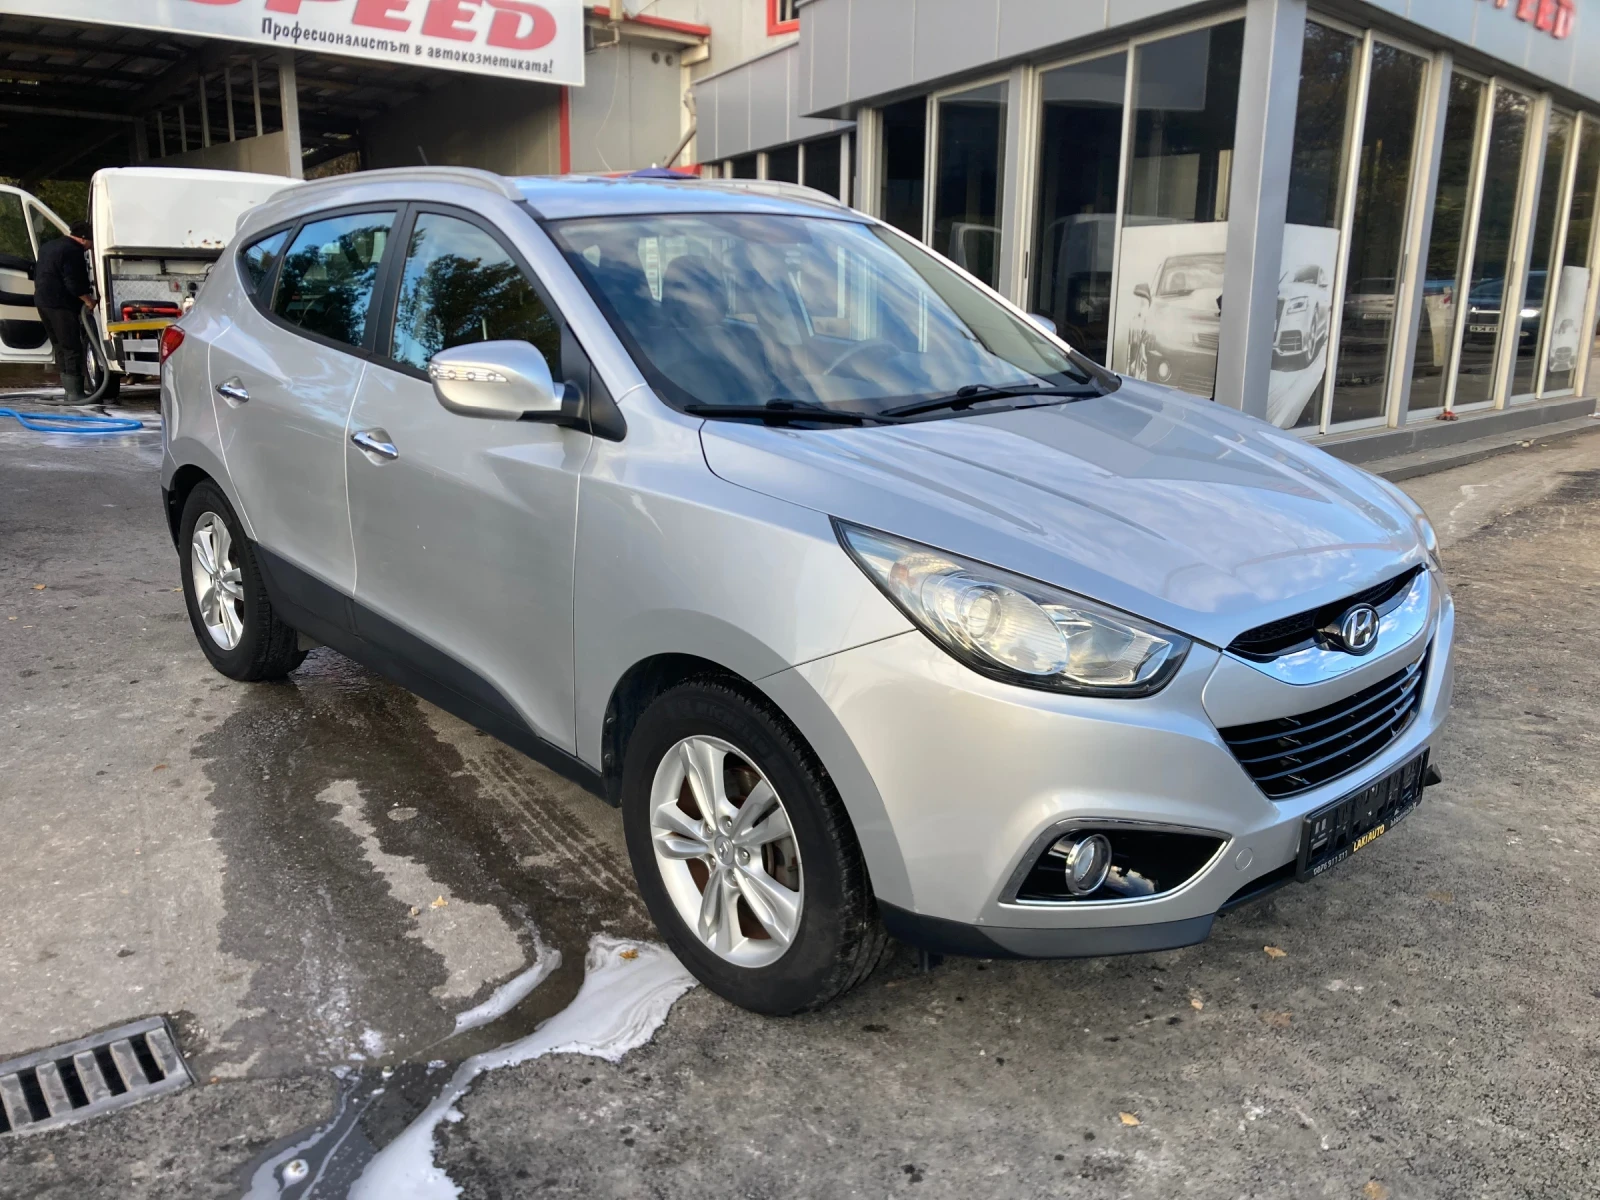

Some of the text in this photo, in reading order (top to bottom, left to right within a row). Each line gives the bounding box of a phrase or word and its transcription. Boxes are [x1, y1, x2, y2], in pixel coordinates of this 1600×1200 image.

[186, 0, 557, 51] EED
[261, 17, 554, 74] Професионалистът в автокозметиката!
